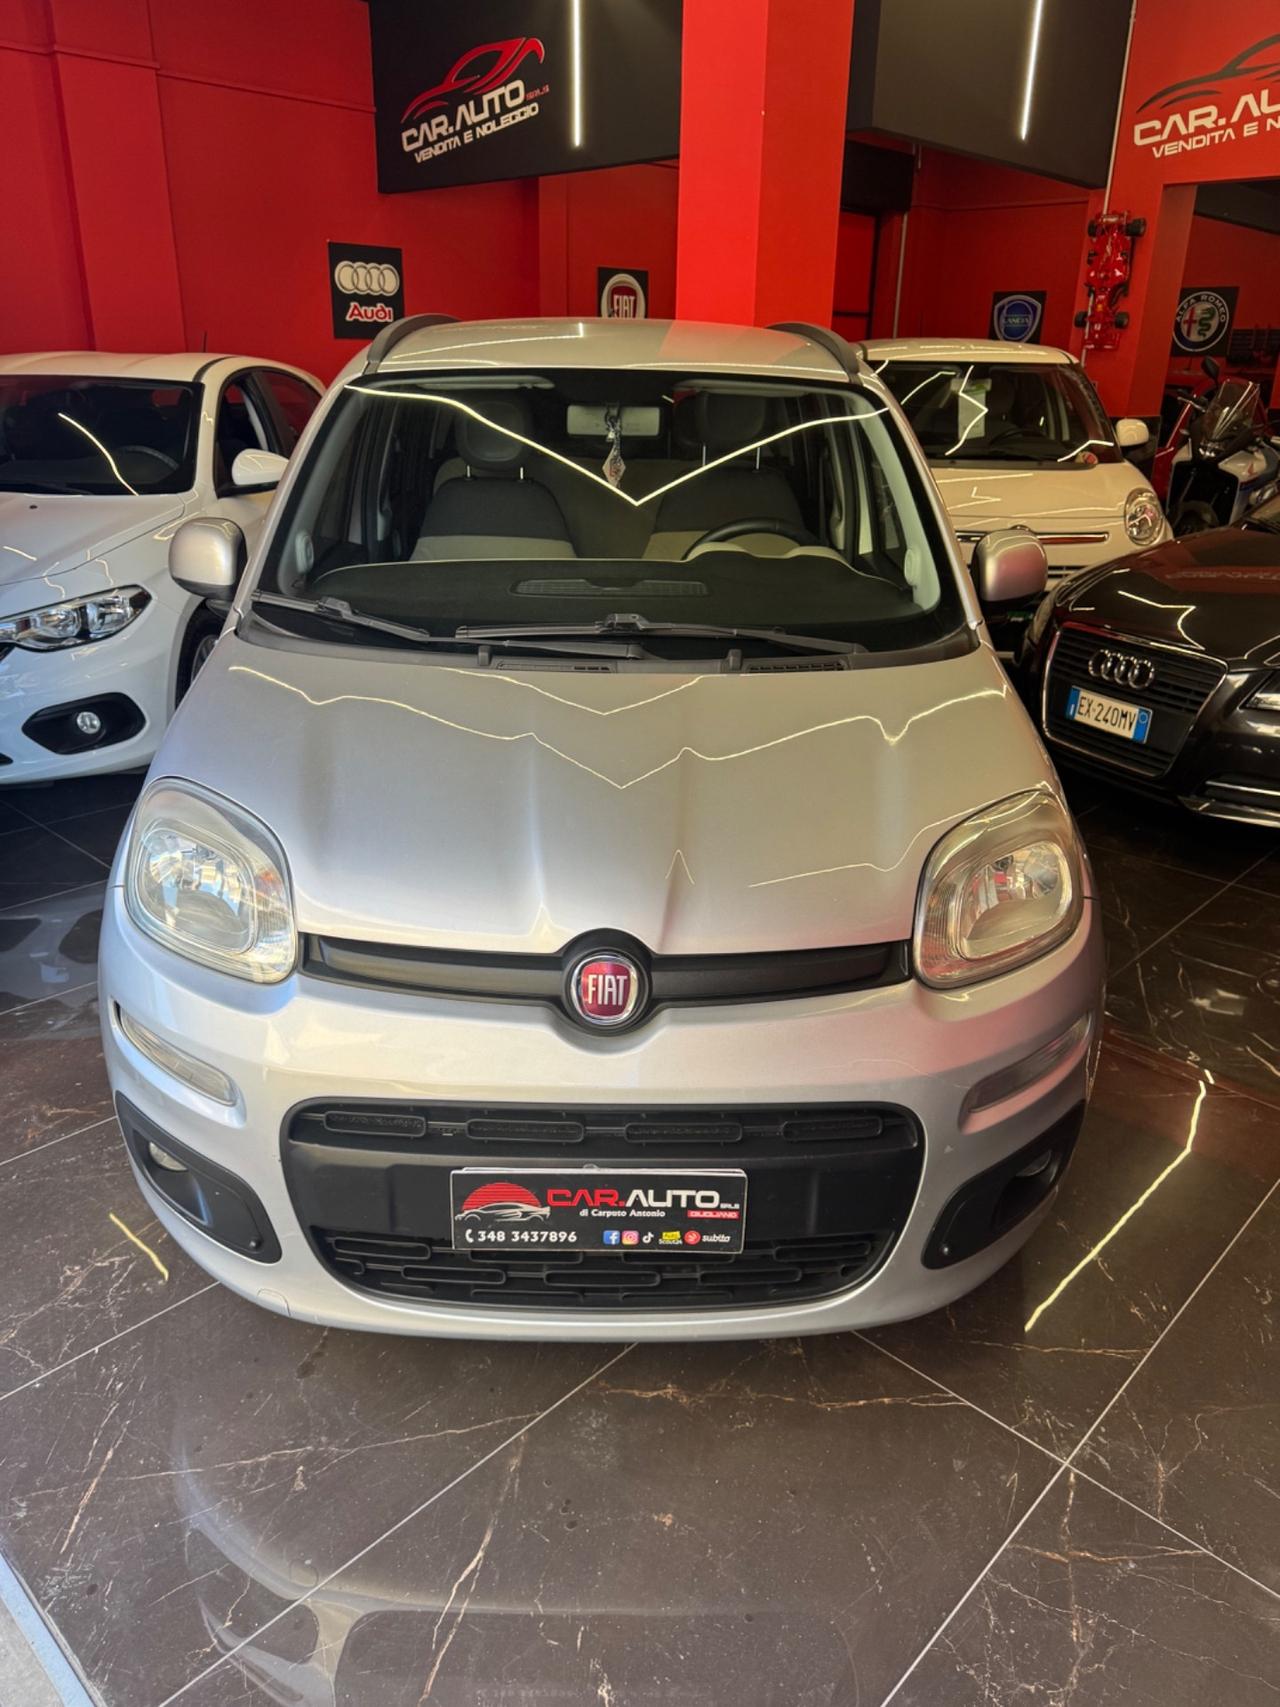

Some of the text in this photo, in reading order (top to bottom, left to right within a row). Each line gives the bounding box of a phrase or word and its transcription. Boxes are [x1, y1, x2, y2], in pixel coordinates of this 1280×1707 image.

[401, 79, 525, 152] CAR.AUTO
[414, 102, 539, 163] VENDITA E NOLEGGIO
[1152, 128, 1235, 159] VENDITA
[1243, 122, 1258, 137] E
[345, 301, 394, 322] Audi
[613, 294, 636, 318] FIAT
[1176, 294, 1227, 323] ALFA ROMEO
[587, 974, 628, 1006] FIAT
[546, 1189, 720, 1208] CAR.AUTO
[579, 1208, 589, 1217] di
[629, 1208, 666, 1217] Antonio
[477, 1231, 578, 1242] 348 3437896
[702, 1233, 731, 1242] subito
